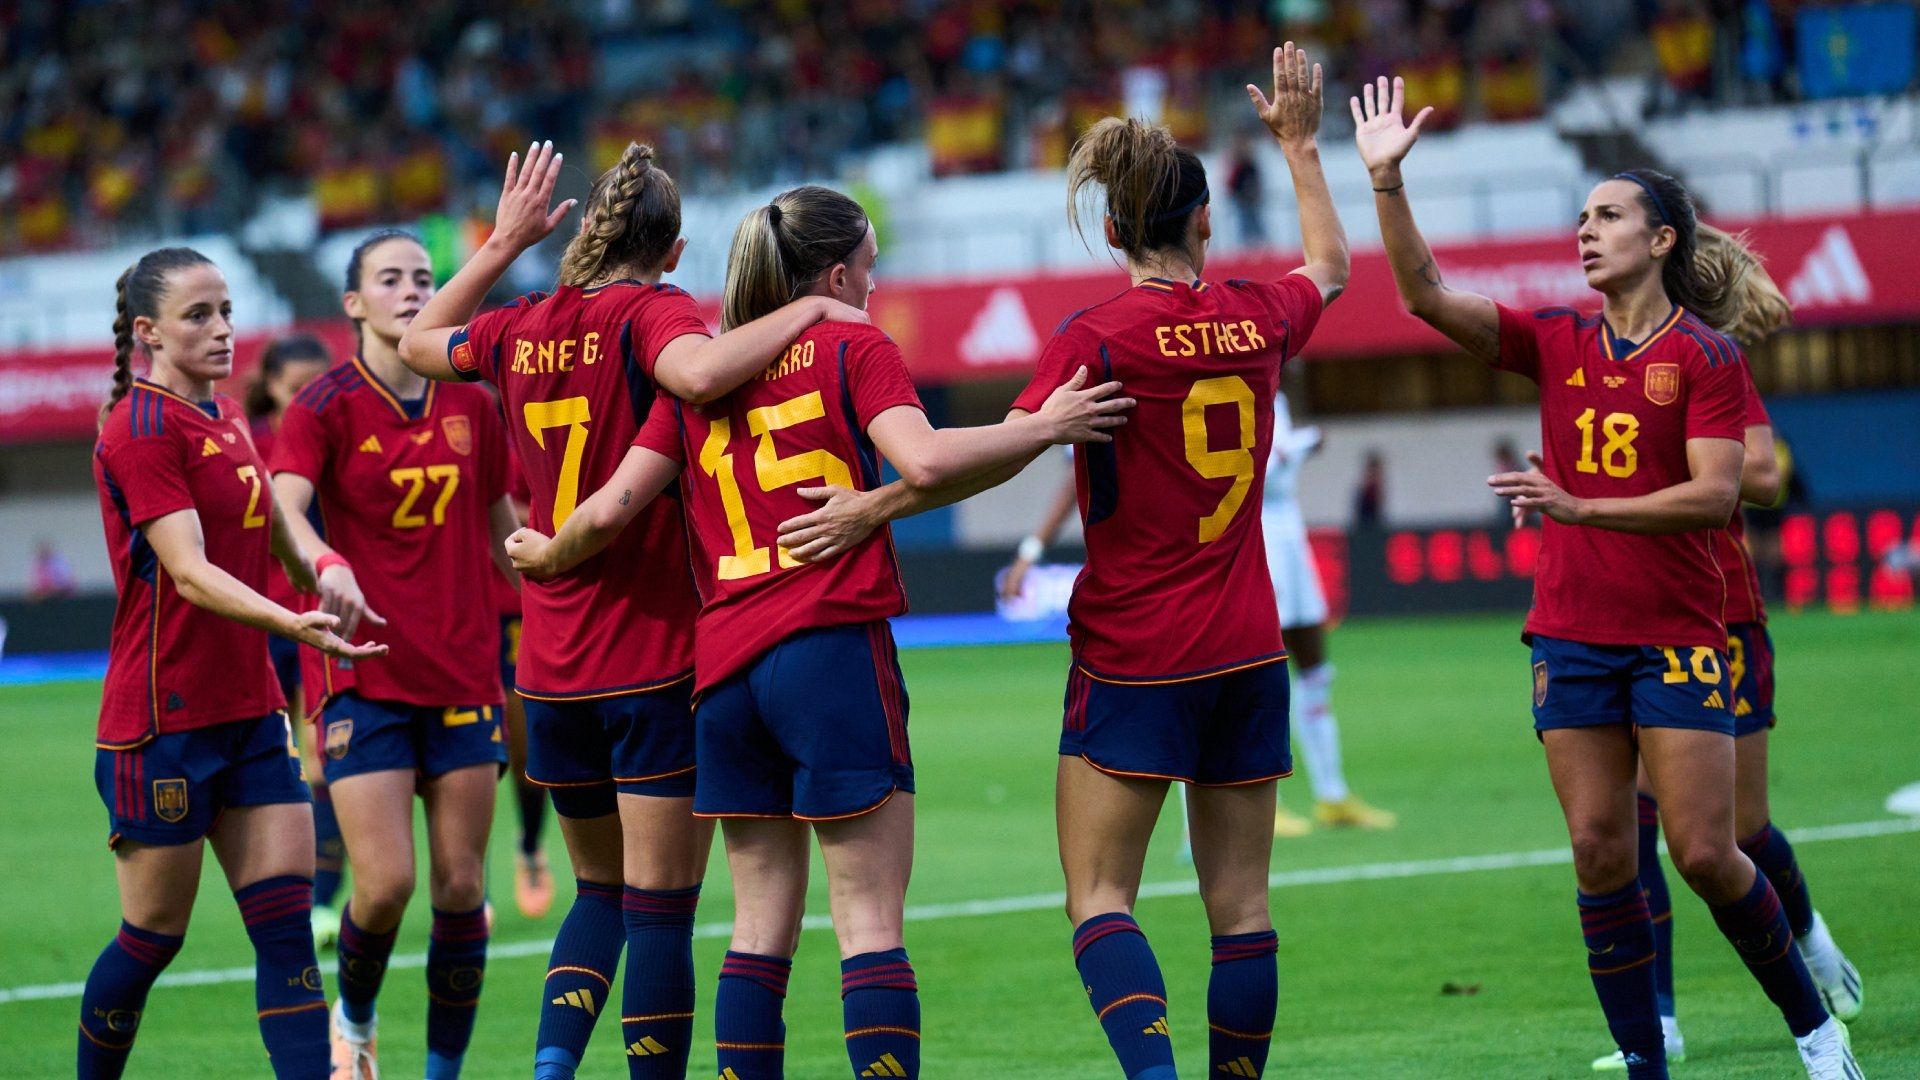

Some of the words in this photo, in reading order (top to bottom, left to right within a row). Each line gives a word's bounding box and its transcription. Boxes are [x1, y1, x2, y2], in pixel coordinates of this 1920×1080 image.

[583, 331, 604, 365] G.
[1155, 319, 1267, 357] ESTHER
[523, 396, 592, 535] 7
[1182, 375, 1256, 544] 9
[1574, 407, 1640, 478] 18
[236, 465, 266, 529] 2
[390, 464, 460, 529] 27
[699, 390, 855, 581] 15
